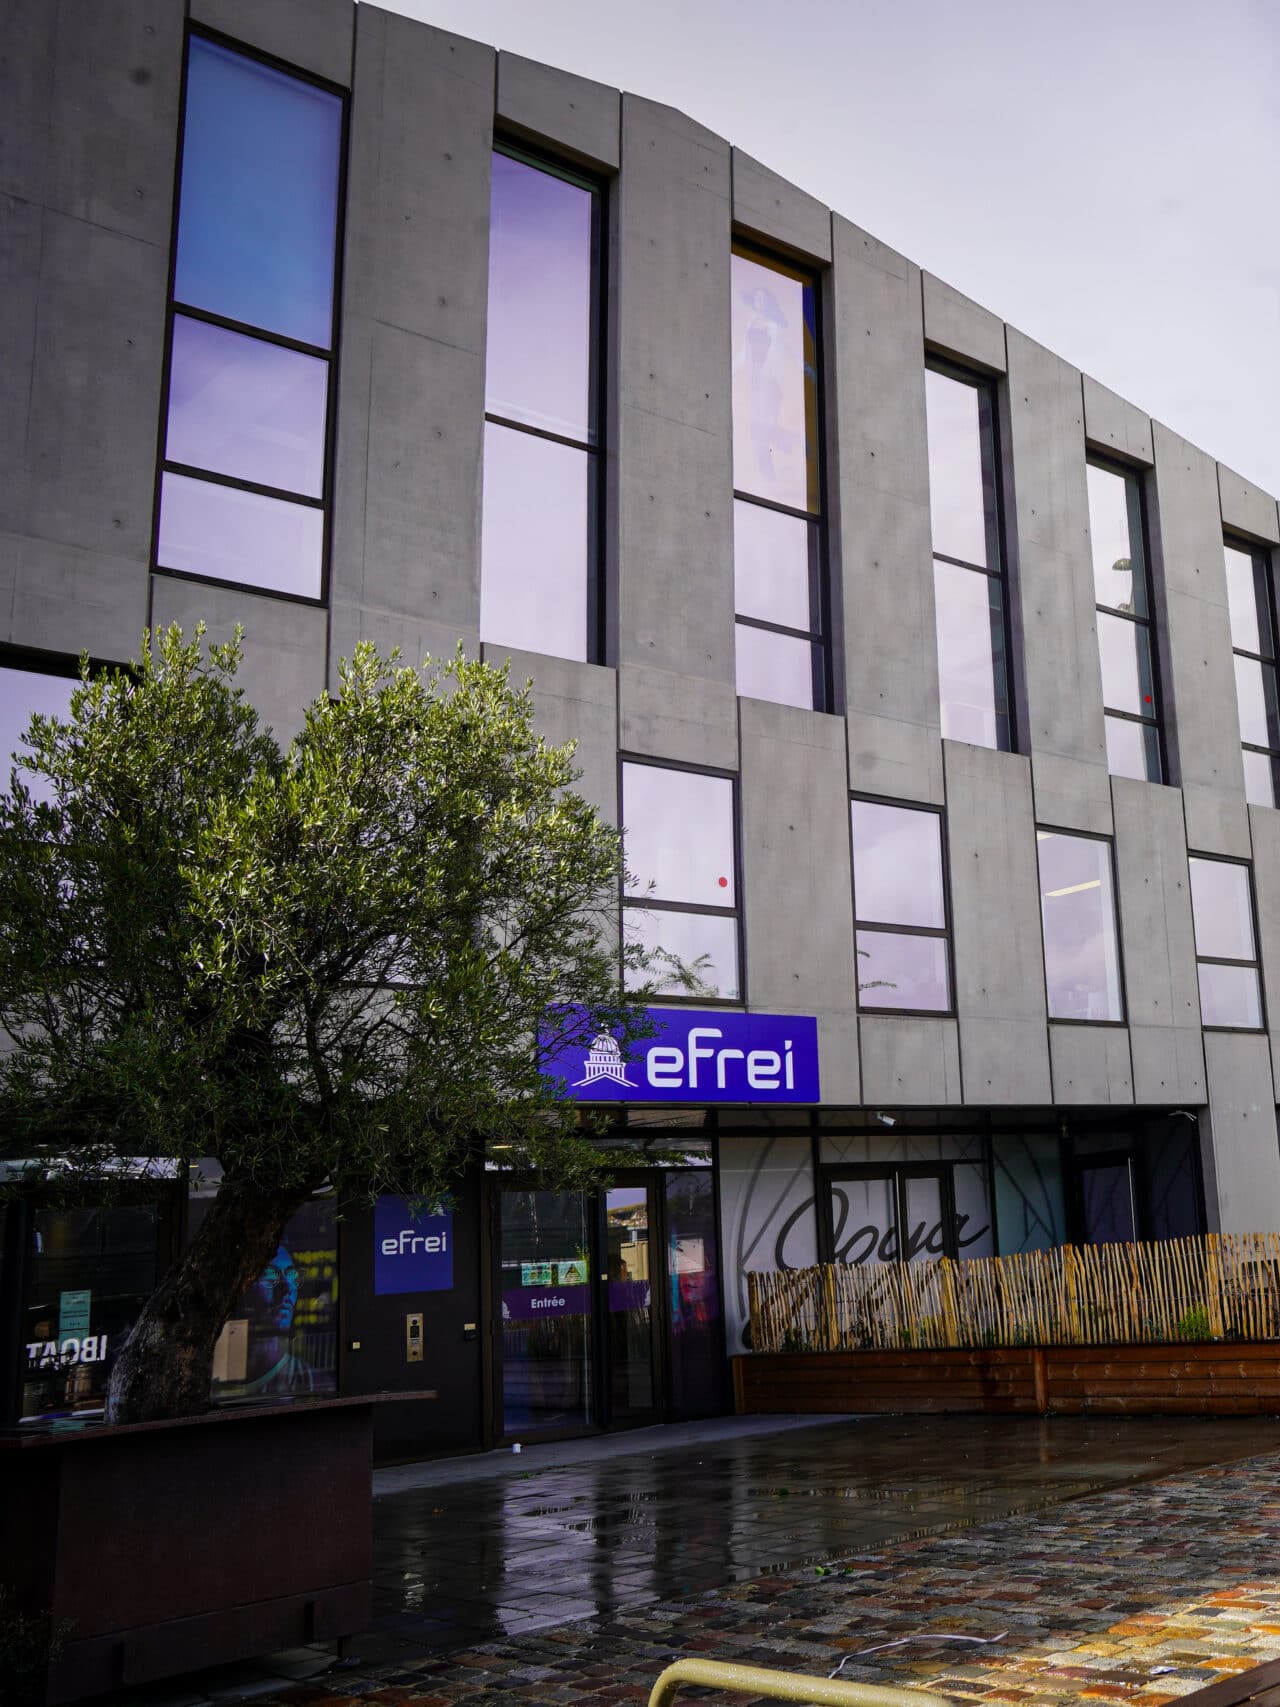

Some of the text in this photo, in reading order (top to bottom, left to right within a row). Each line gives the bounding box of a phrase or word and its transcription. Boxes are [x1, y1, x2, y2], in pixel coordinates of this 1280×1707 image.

[646, 1027, 795, 1090] efrei
[381, 1229, 447, 1256] efrei
[530, 1295, 567, 1310] Entrée
